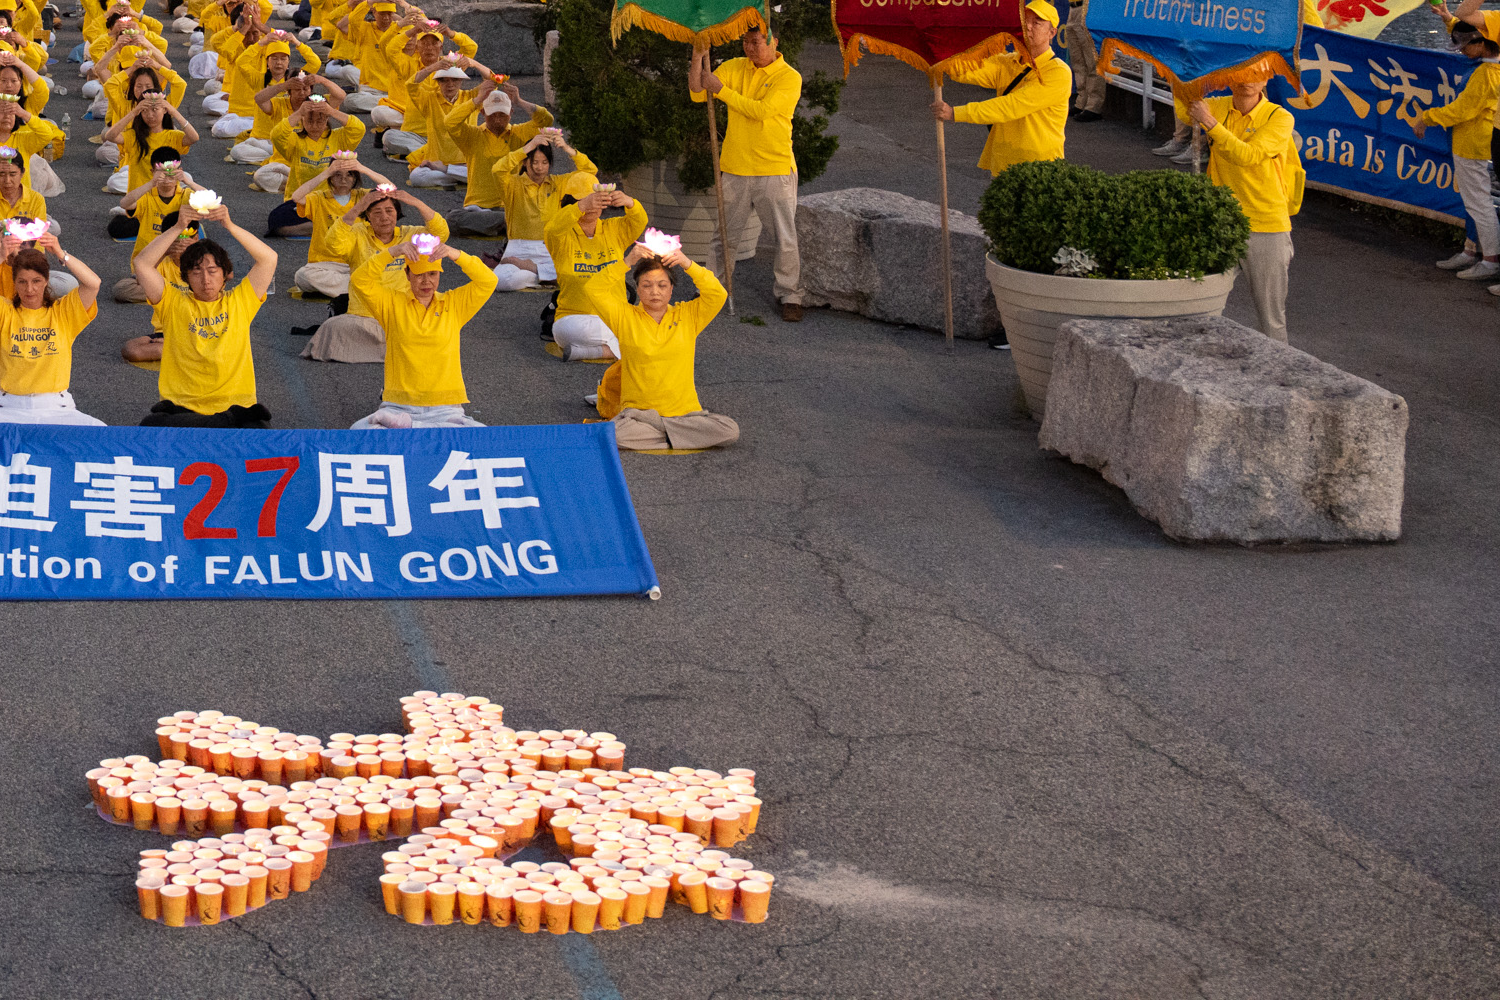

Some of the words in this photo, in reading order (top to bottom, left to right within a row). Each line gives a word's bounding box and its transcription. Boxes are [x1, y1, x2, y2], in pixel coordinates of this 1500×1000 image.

[1361, 135, 1386, 174] Is
[128, 554, 179, 584] of
[205, 551, 375, 585] FALUN
[400, 539, 559, 583] GONG
